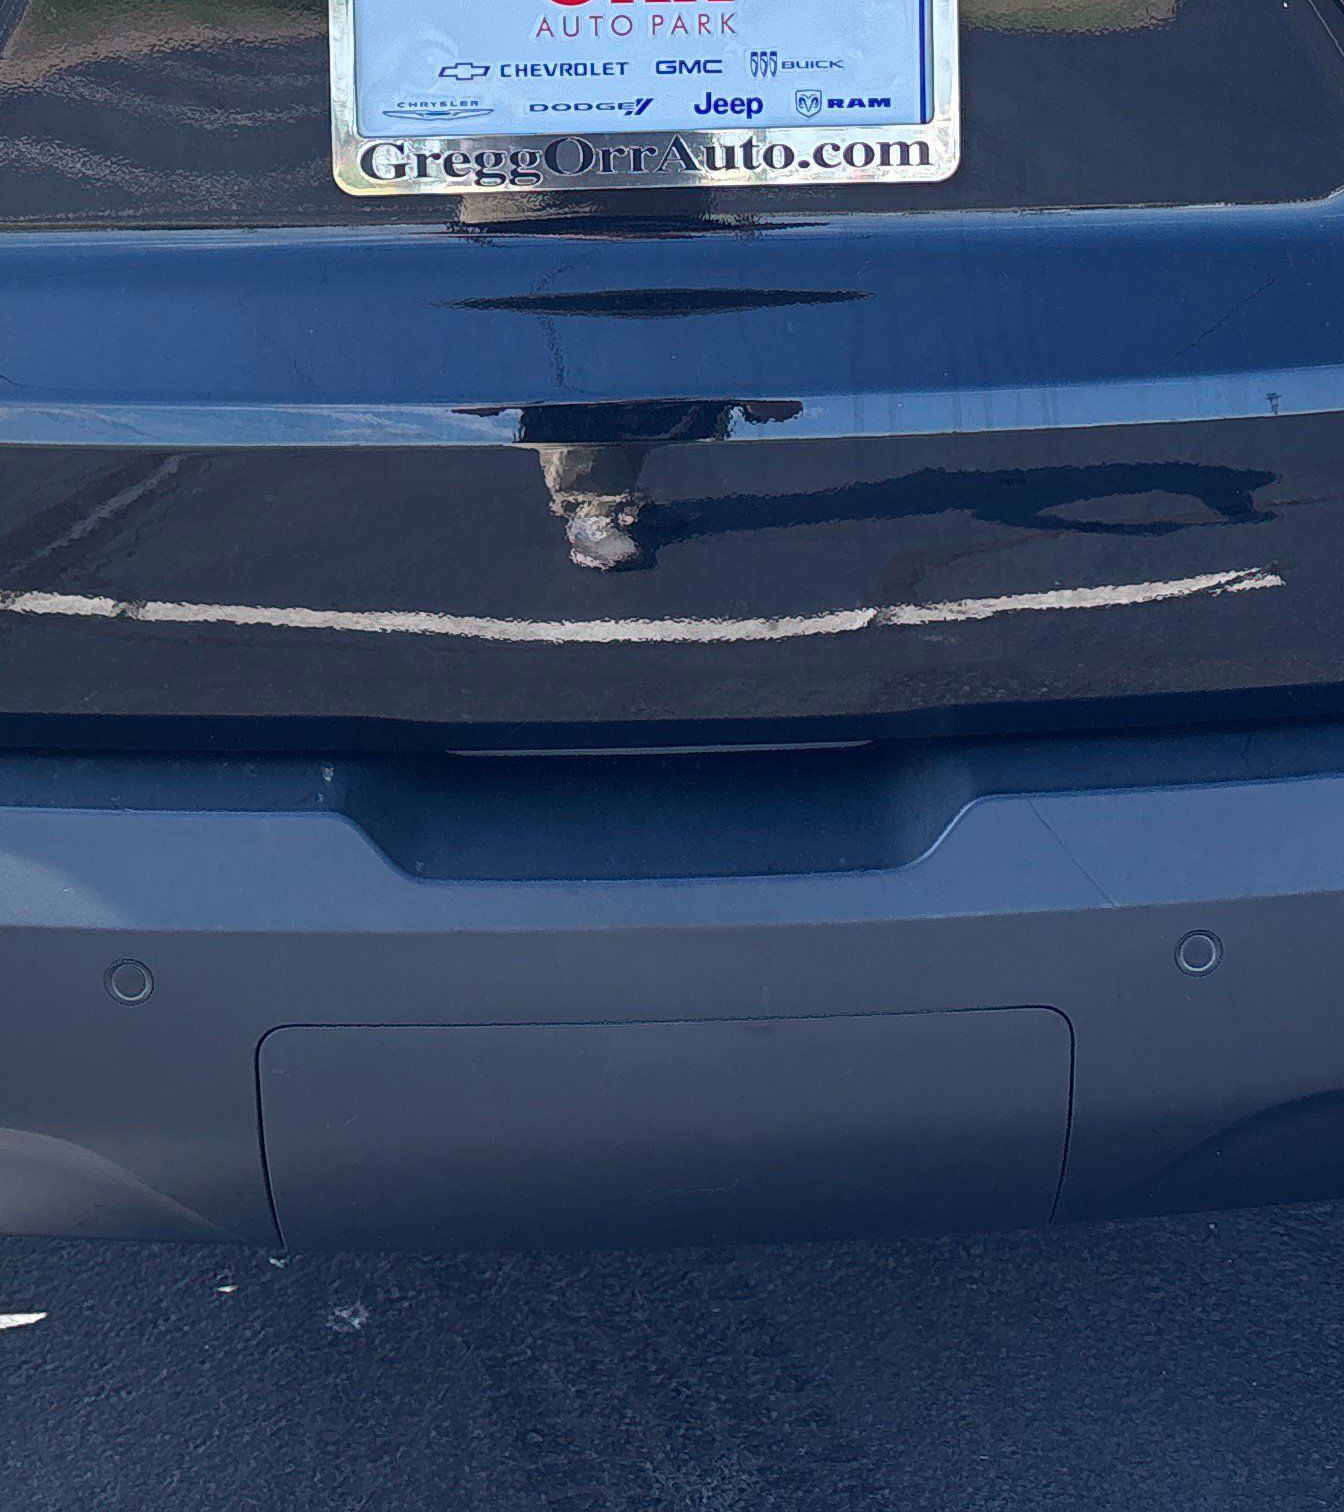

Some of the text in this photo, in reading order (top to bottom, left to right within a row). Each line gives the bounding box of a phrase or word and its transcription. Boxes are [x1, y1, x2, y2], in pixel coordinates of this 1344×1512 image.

[535, 12, 737, 38] AUTO PARK
[499, 59, 845, 78] CHEVROLET GMC BUICK
[396, 91, 892, 119] CHRYSLER DODGE Jeep RAM
[359, 132, 931, 188] GreggOrrAuto.com
